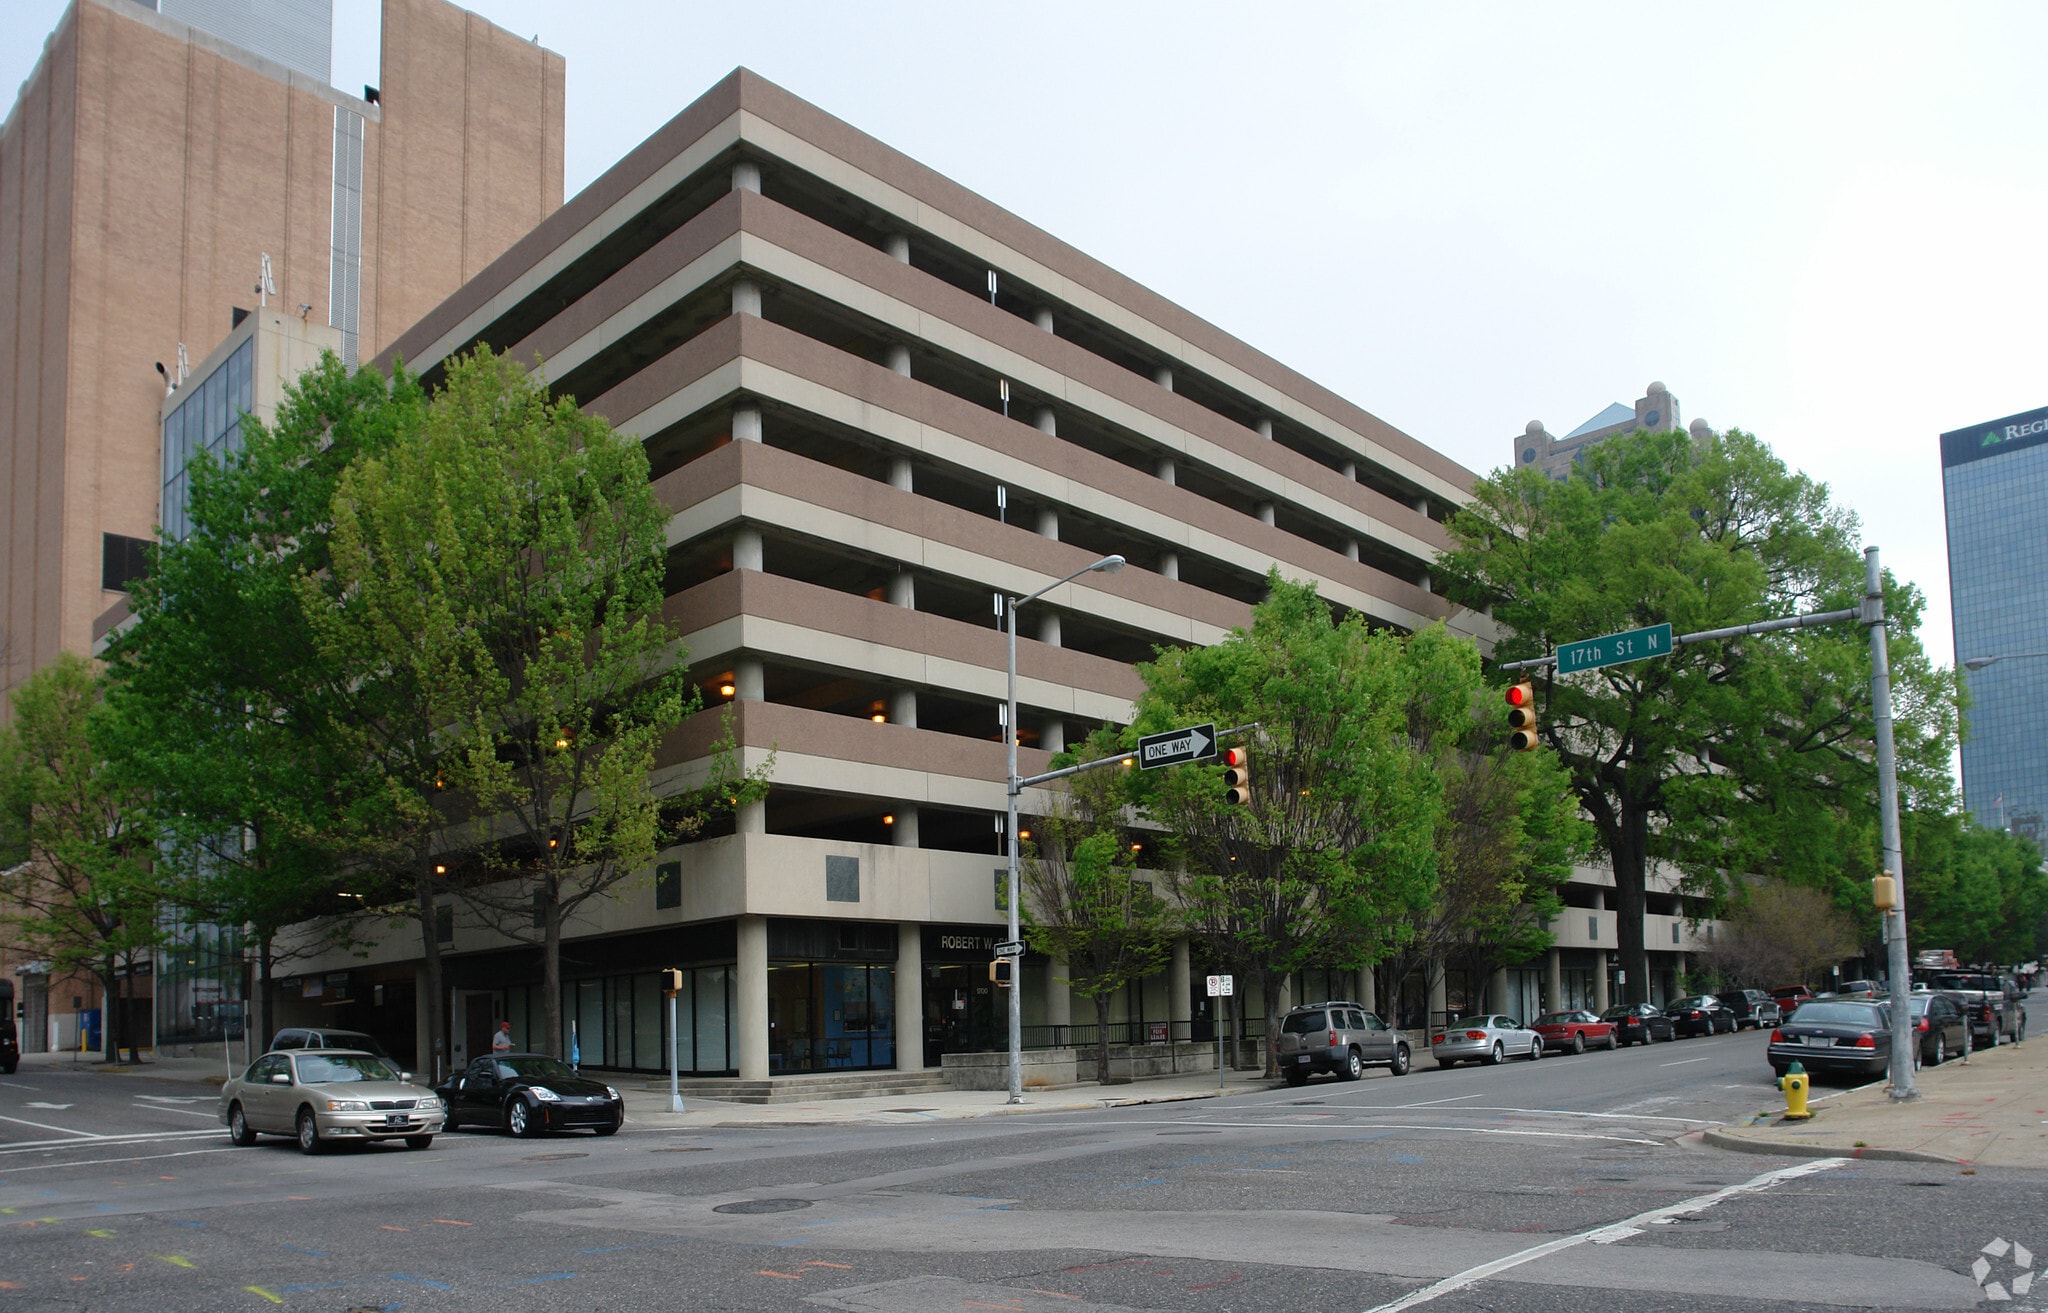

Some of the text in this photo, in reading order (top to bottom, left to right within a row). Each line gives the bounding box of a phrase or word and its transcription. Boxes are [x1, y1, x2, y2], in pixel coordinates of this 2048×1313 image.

[1570, 633, 1658, 665] 17th St N
[1148, 738, 1192, 758] ONE WAY
[941, 935, 980, 949] ROBERT
